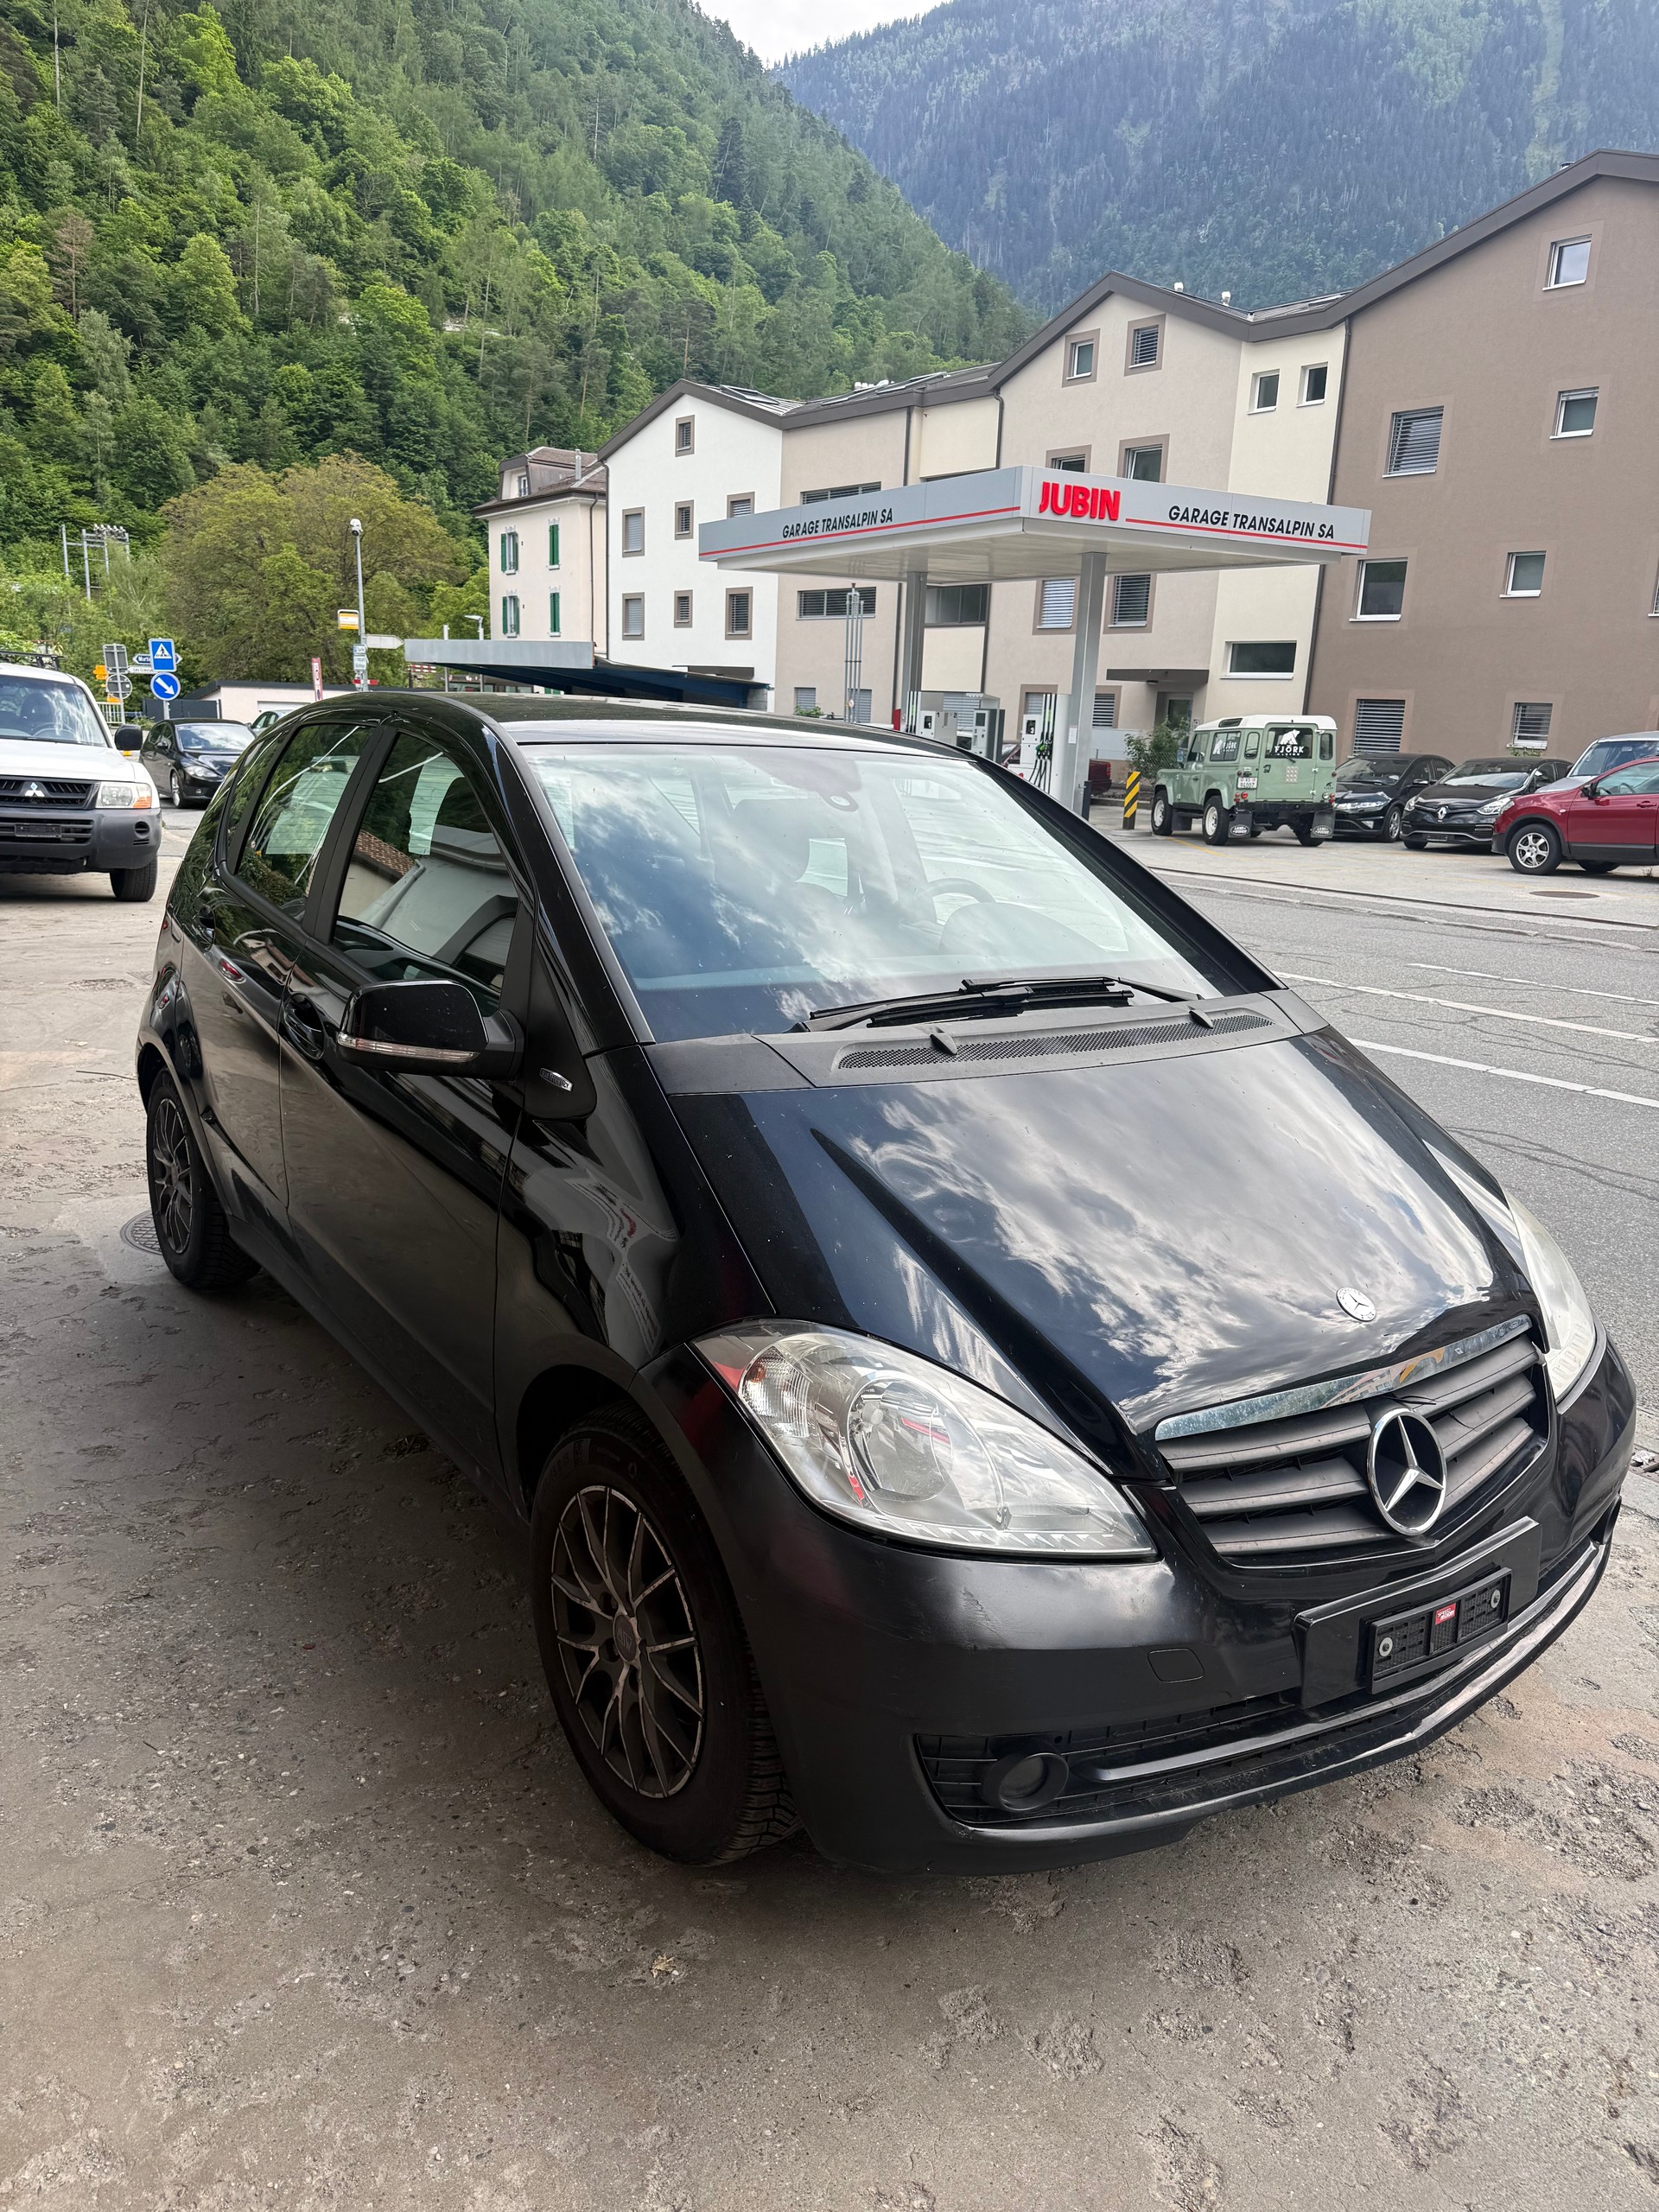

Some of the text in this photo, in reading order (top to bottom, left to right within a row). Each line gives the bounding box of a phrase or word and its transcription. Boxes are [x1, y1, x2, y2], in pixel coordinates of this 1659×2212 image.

[1039, 481, 1121, 521] JUBIN
[782, 507, 893, 538] GARAGE TRANSALPIN SA
[1168, 505, 1335, 539] GARAGE TRANSALPIN SA
